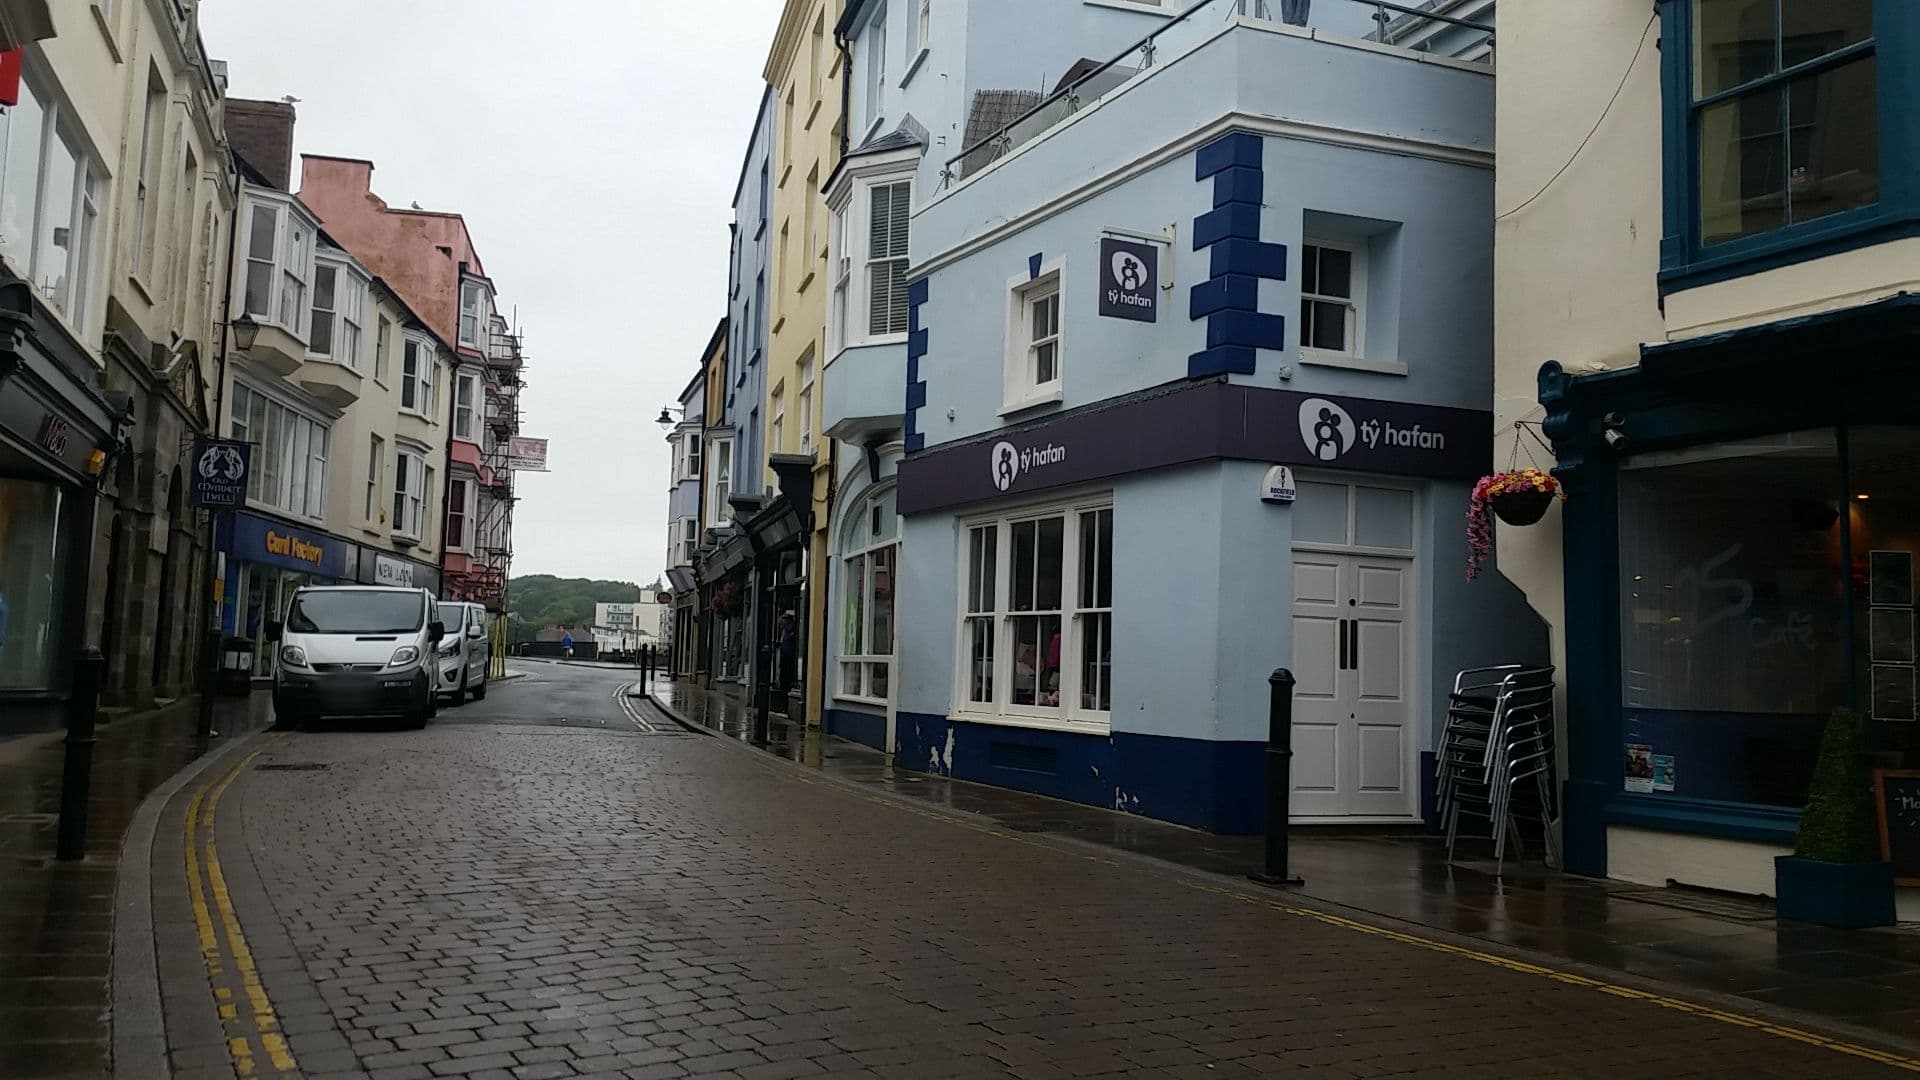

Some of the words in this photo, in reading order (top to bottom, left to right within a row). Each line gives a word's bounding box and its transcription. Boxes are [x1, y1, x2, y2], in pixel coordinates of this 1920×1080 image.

[1120, 291, 1152, 308] hafan
[1385, 421, 1445, 450] hafan
[1032, 443, 1065, 467] hafan
[266, 531, 290, 556] Card
[291, 536, 324, 567] Factory
[378, 562, 393, 578] NEW
[395, 567, 413, 583] LOOK
